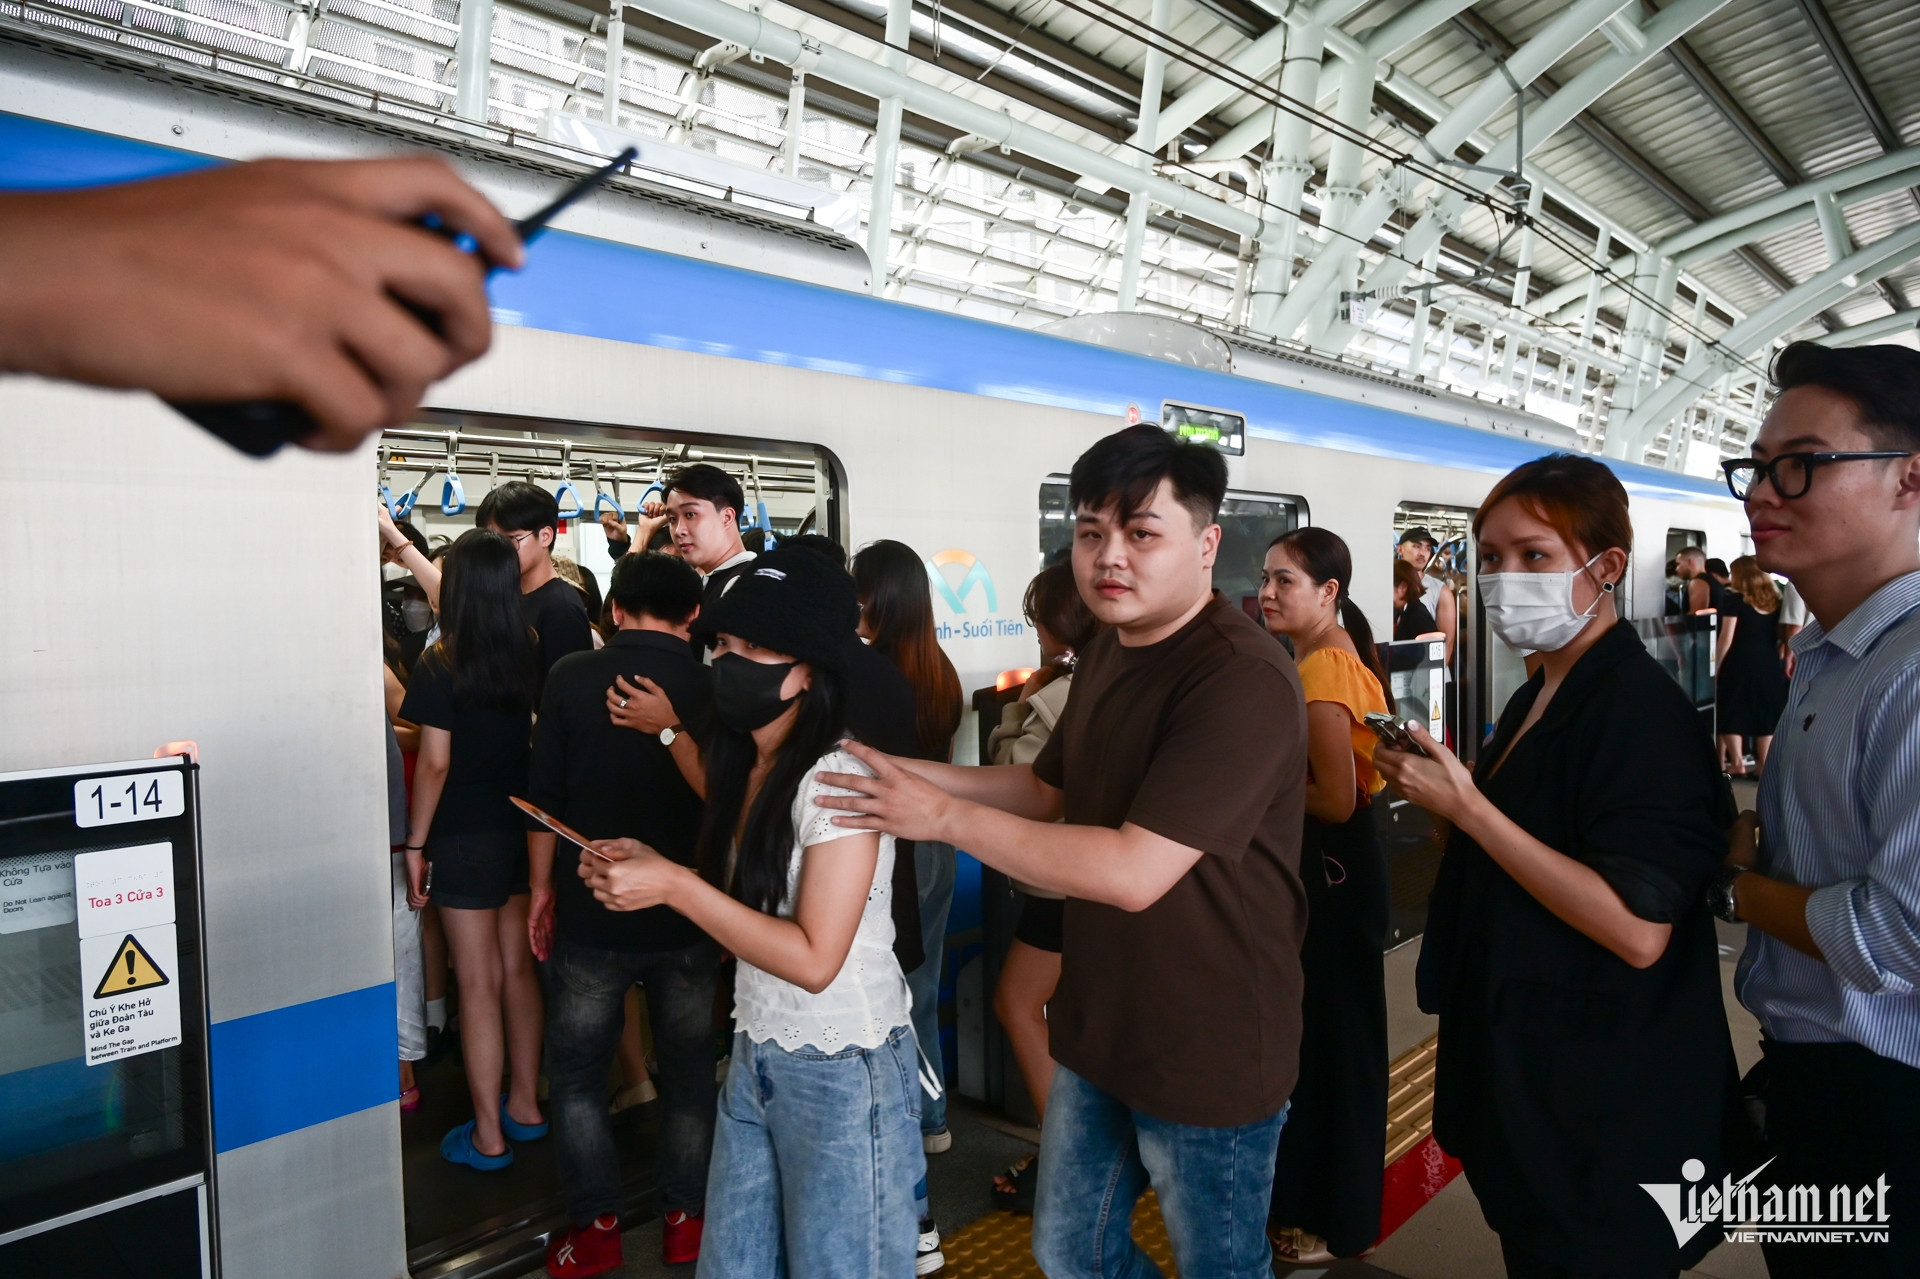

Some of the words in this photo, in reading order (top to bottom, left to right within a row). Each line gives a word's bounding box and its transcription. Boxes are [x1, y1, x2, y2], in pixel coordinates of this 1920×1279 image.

[995, 619, 1023, 636] Tiên
[91, 779, 162, 820] 1-14
[33, 864, 52, 873] Tựa
[54, 861, 72, 870] vào
[3, 877, 23, 887] Cửa
[15, 898, 27, 906] Not
[47, 891, 72, 902] against
[88, 897, 112, 909] Toa
[115, 893, 123, 905] 3
[127, 888, 153, 902] Cửa
[156, 886, 164, 898] 3
[3, 906, 24, 914] Doors
[89, 1007, 107, 1018] Chú
[109, 1004, 116, 1014] Ý
[118, 1003, 136, 1012] Khe
[138, 997, 152, 1008] Hở
[89, 1018, 110, 1031] giữa
[112, 1013, 135, 1024] Đoàn
[138, 1009, 154, 1018] Tàu
[90, 1031, 101, 1039] và
[103, 1028, 116, 1037] Ke
[118, 1025, 130, 1033] Ga
[90, 1044, 107, 1053] Mind
[122, 1038, 135, 1047] Gap
[91, 1049, 119, 1061] between
[120, 1046, 137, 1054] Train
[138, 1042, 150, 1050] and
[150, 1035, 178, 1047] Platform
